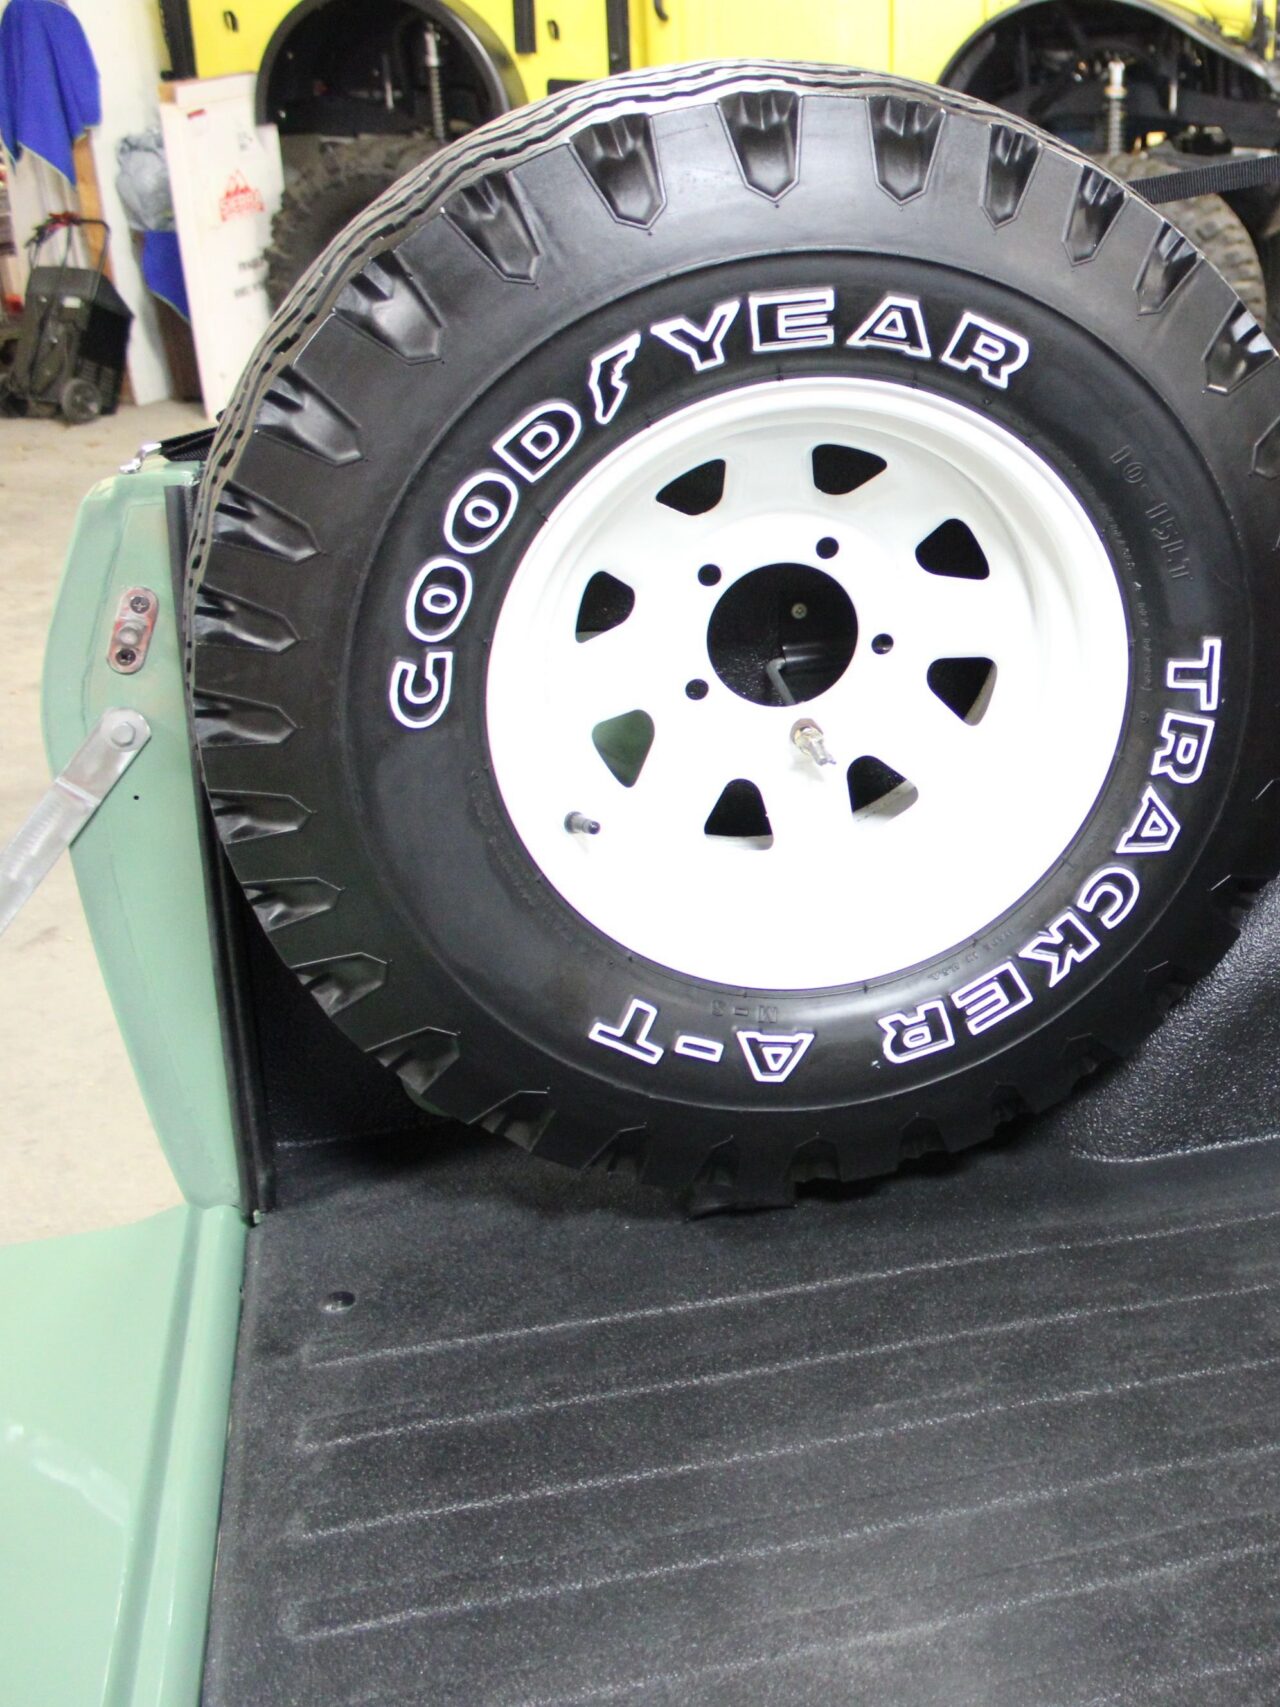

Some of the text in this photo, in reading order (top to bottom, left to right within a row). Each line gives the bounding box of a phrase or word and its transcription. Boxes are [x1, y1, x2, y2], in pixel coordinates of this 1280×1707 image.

[389, 287, 1030, 729] GOODYEAR
[588, 999, 814, 1083] A-T
[878, 635, 1224, 1064] TRACKER
